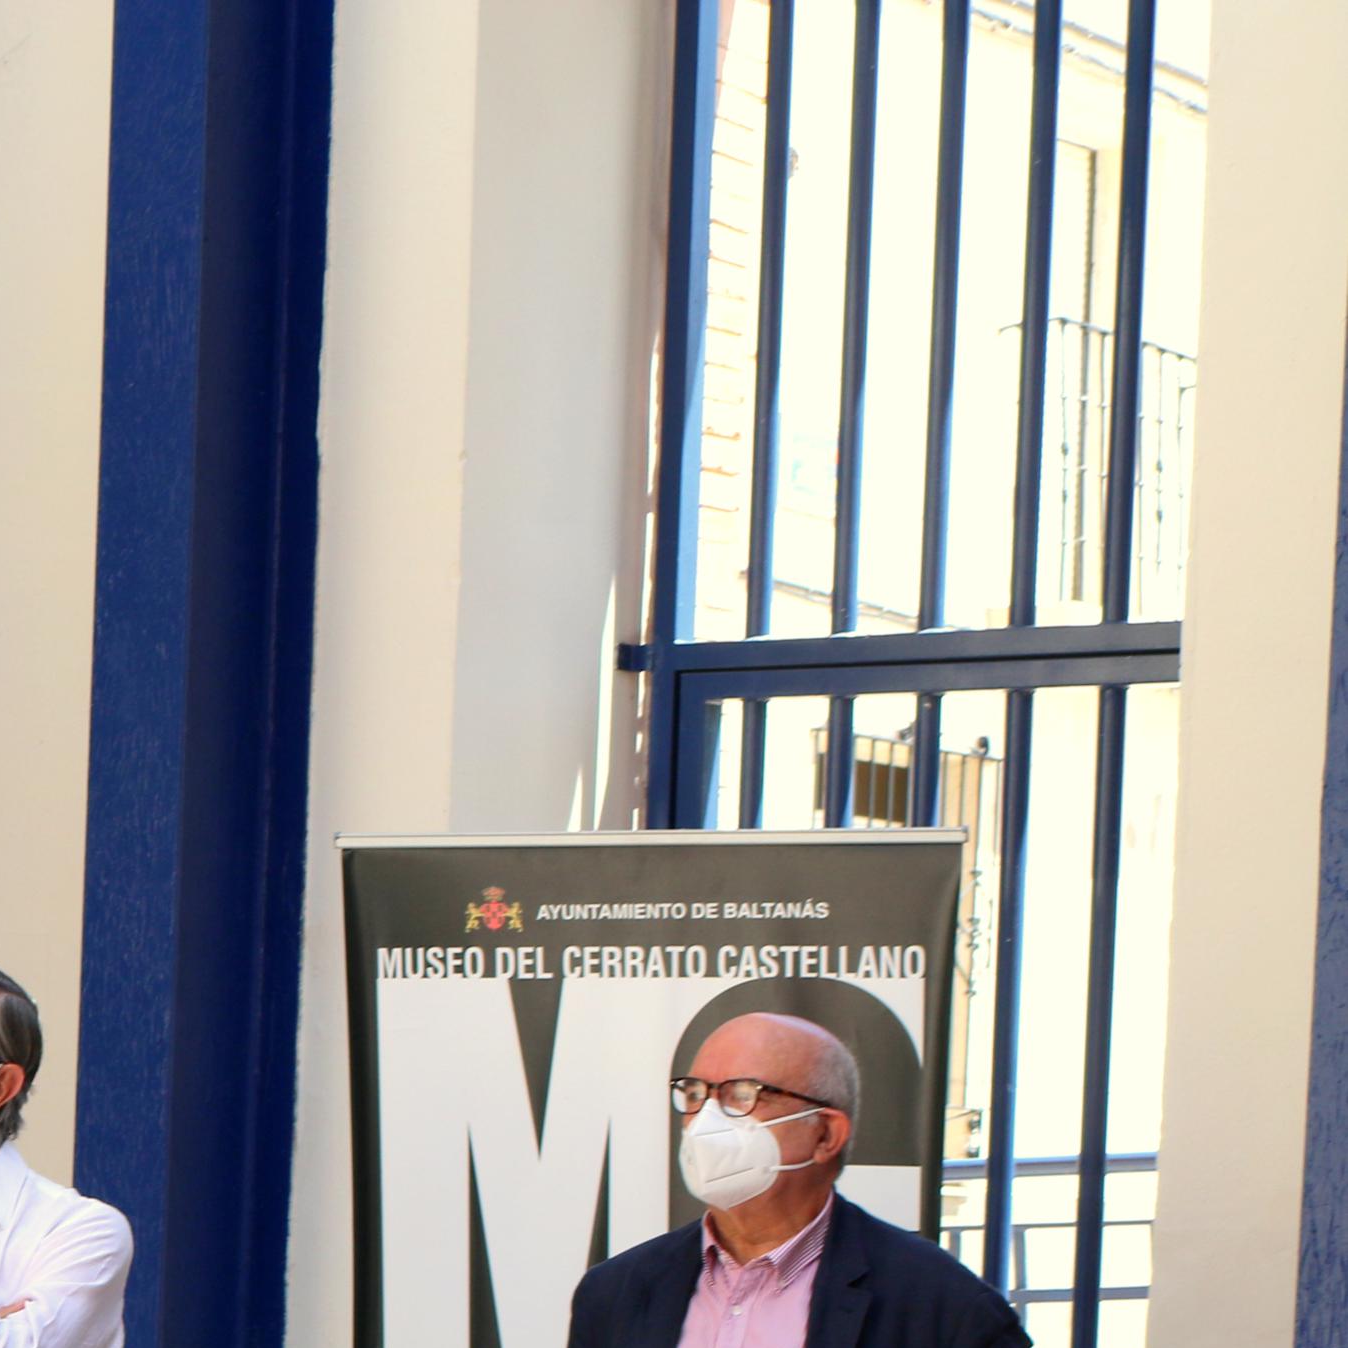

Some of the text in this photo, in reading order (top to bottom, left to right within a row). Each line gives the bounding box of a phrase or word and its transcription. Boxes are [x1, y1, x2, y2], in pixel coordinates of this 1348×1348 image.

[536, 899, 831, 921] AYUNTAMIENTO DE BALTANÁS
[377, 945, 927, 980] MUSEO DEL CERRATO CASTELLANO
